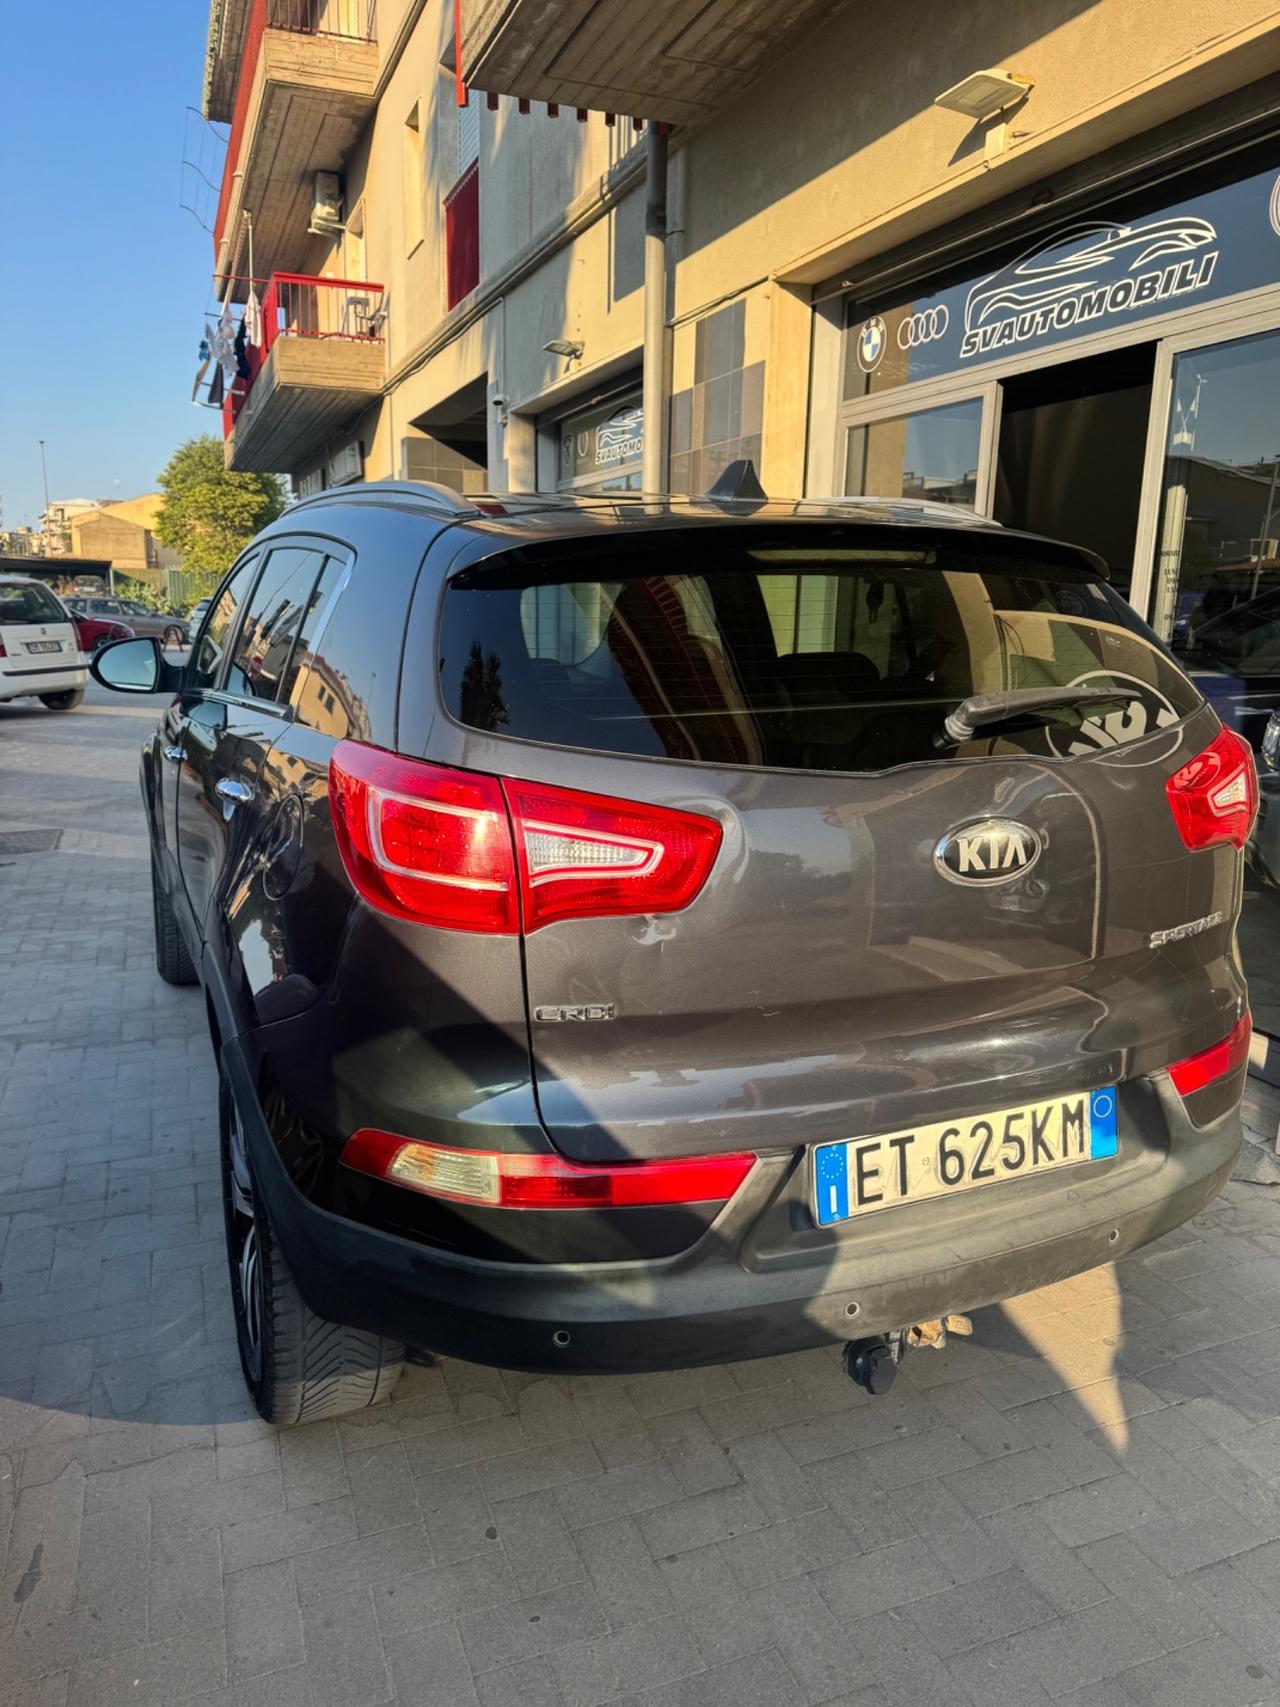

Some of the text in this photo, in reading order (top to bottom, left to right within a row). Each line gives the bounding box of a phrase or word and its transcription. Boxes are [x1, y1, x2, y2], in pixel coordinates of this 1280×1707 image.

[959, 251, 1219, 358] SVAUTOMOBILI
[595, 437, 644, 465] SVAUTOMO
[957, 836, 1027, 873] KIA
[856, 1099, 1084, 1206] ET 625KM
